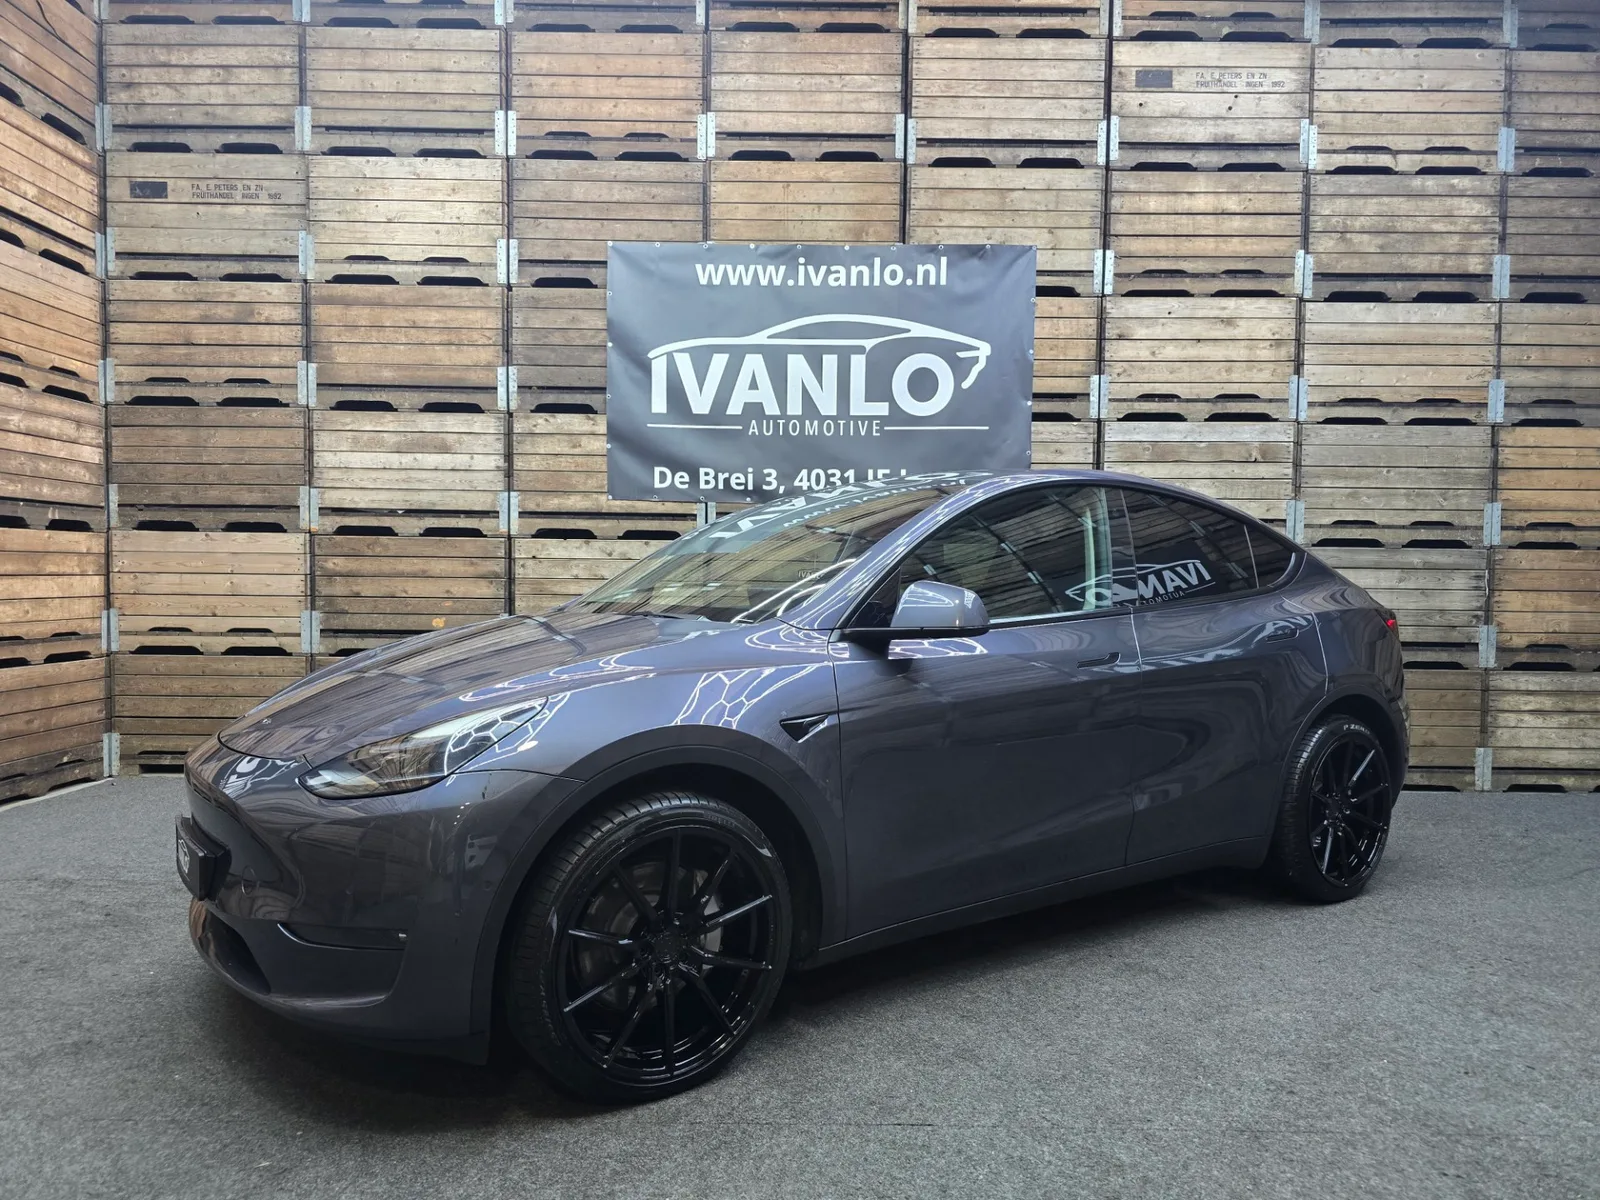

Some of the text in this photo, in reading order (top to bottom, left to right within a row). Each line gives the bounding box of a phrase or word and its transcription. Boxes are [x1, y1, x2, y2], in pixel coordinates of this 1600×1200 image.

[1218, 72, 1243, 80] PETERS
[192, 191, 234, 199] FRUITHANDEL
[214, 184, 239, 192] PETERS
[242, 184, 252, 192] EN
[695, 256, 948, 287] www.ivanlo.nl
[650, 352, 955, 417] IVANLO
[748, 419, 881, 437] AUTOMOTIVE
[653, 466, 690, 489] De
[699, 467, 754, 490] Brei
[762, 468, 786, 494] 3,
[793, 468, 855, 491] 4031
